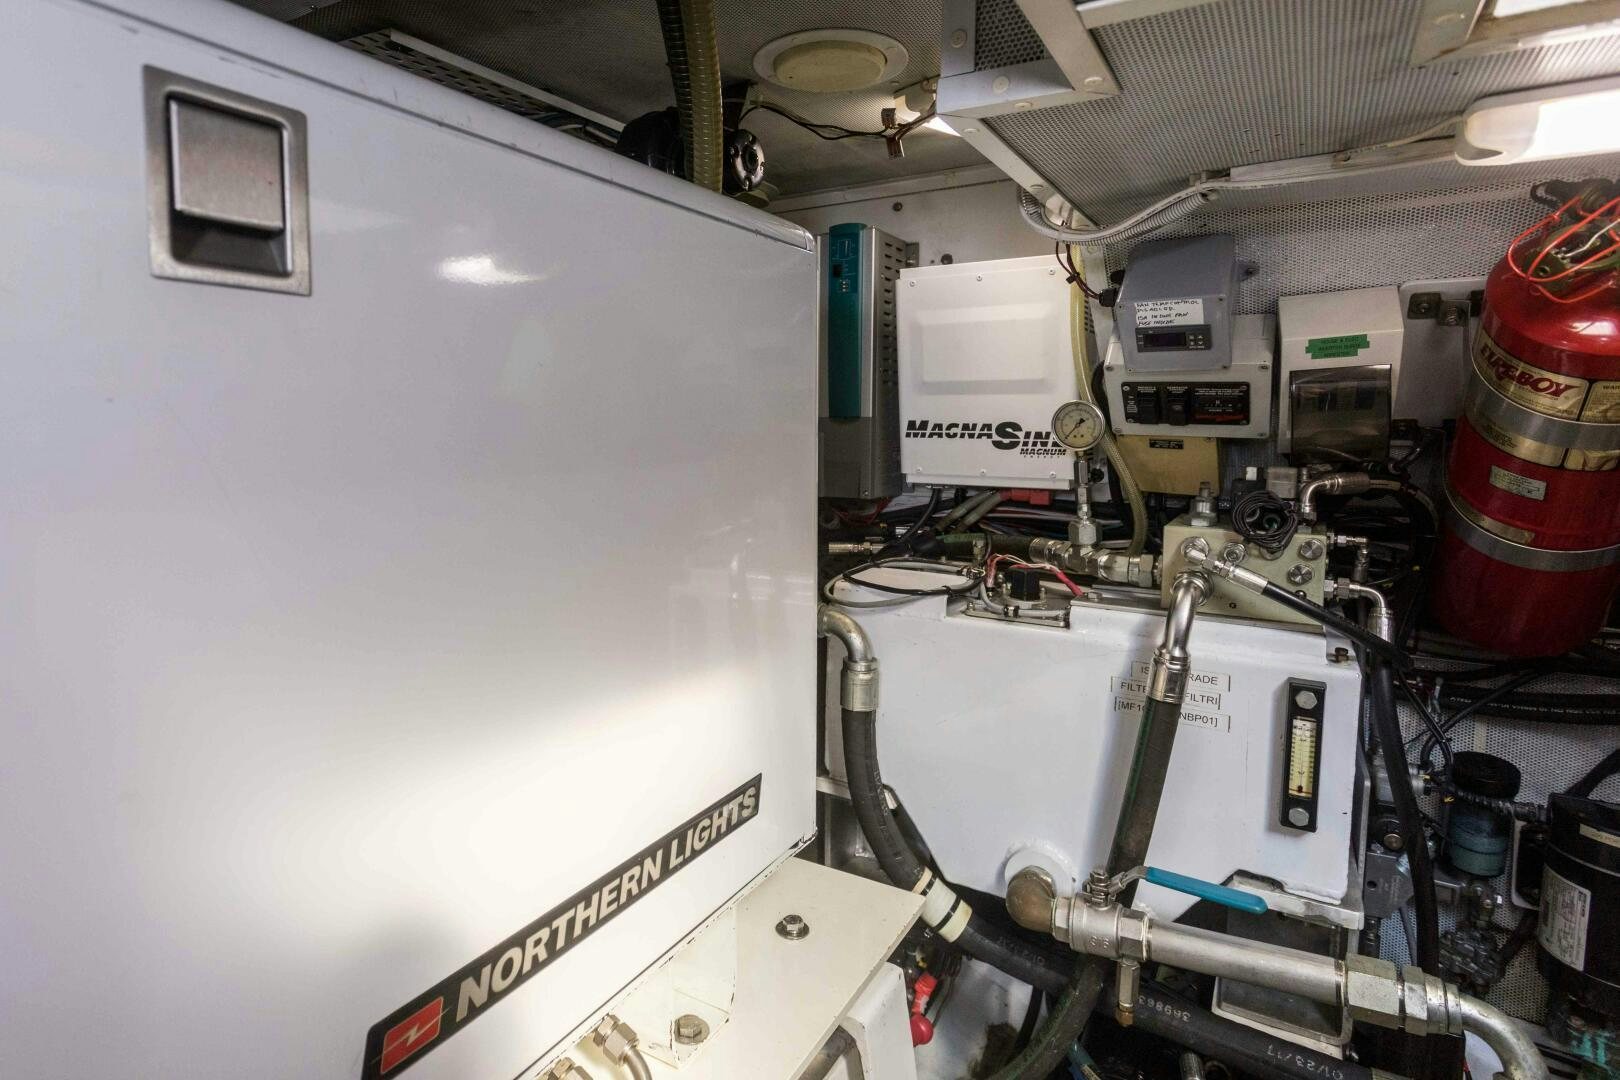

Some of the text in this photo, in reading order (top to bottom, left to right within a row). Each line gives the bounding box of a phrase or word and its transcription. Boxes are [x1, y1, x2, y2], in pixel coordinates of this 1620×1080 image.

[1020, 448, 1067, 456] MAGNUM
[1189, 673, 1218, 686] RADE
[1120, 681, 1146, 693] FILTE
[455, 786, 757, 1023] NORTHERN LIGHTS
